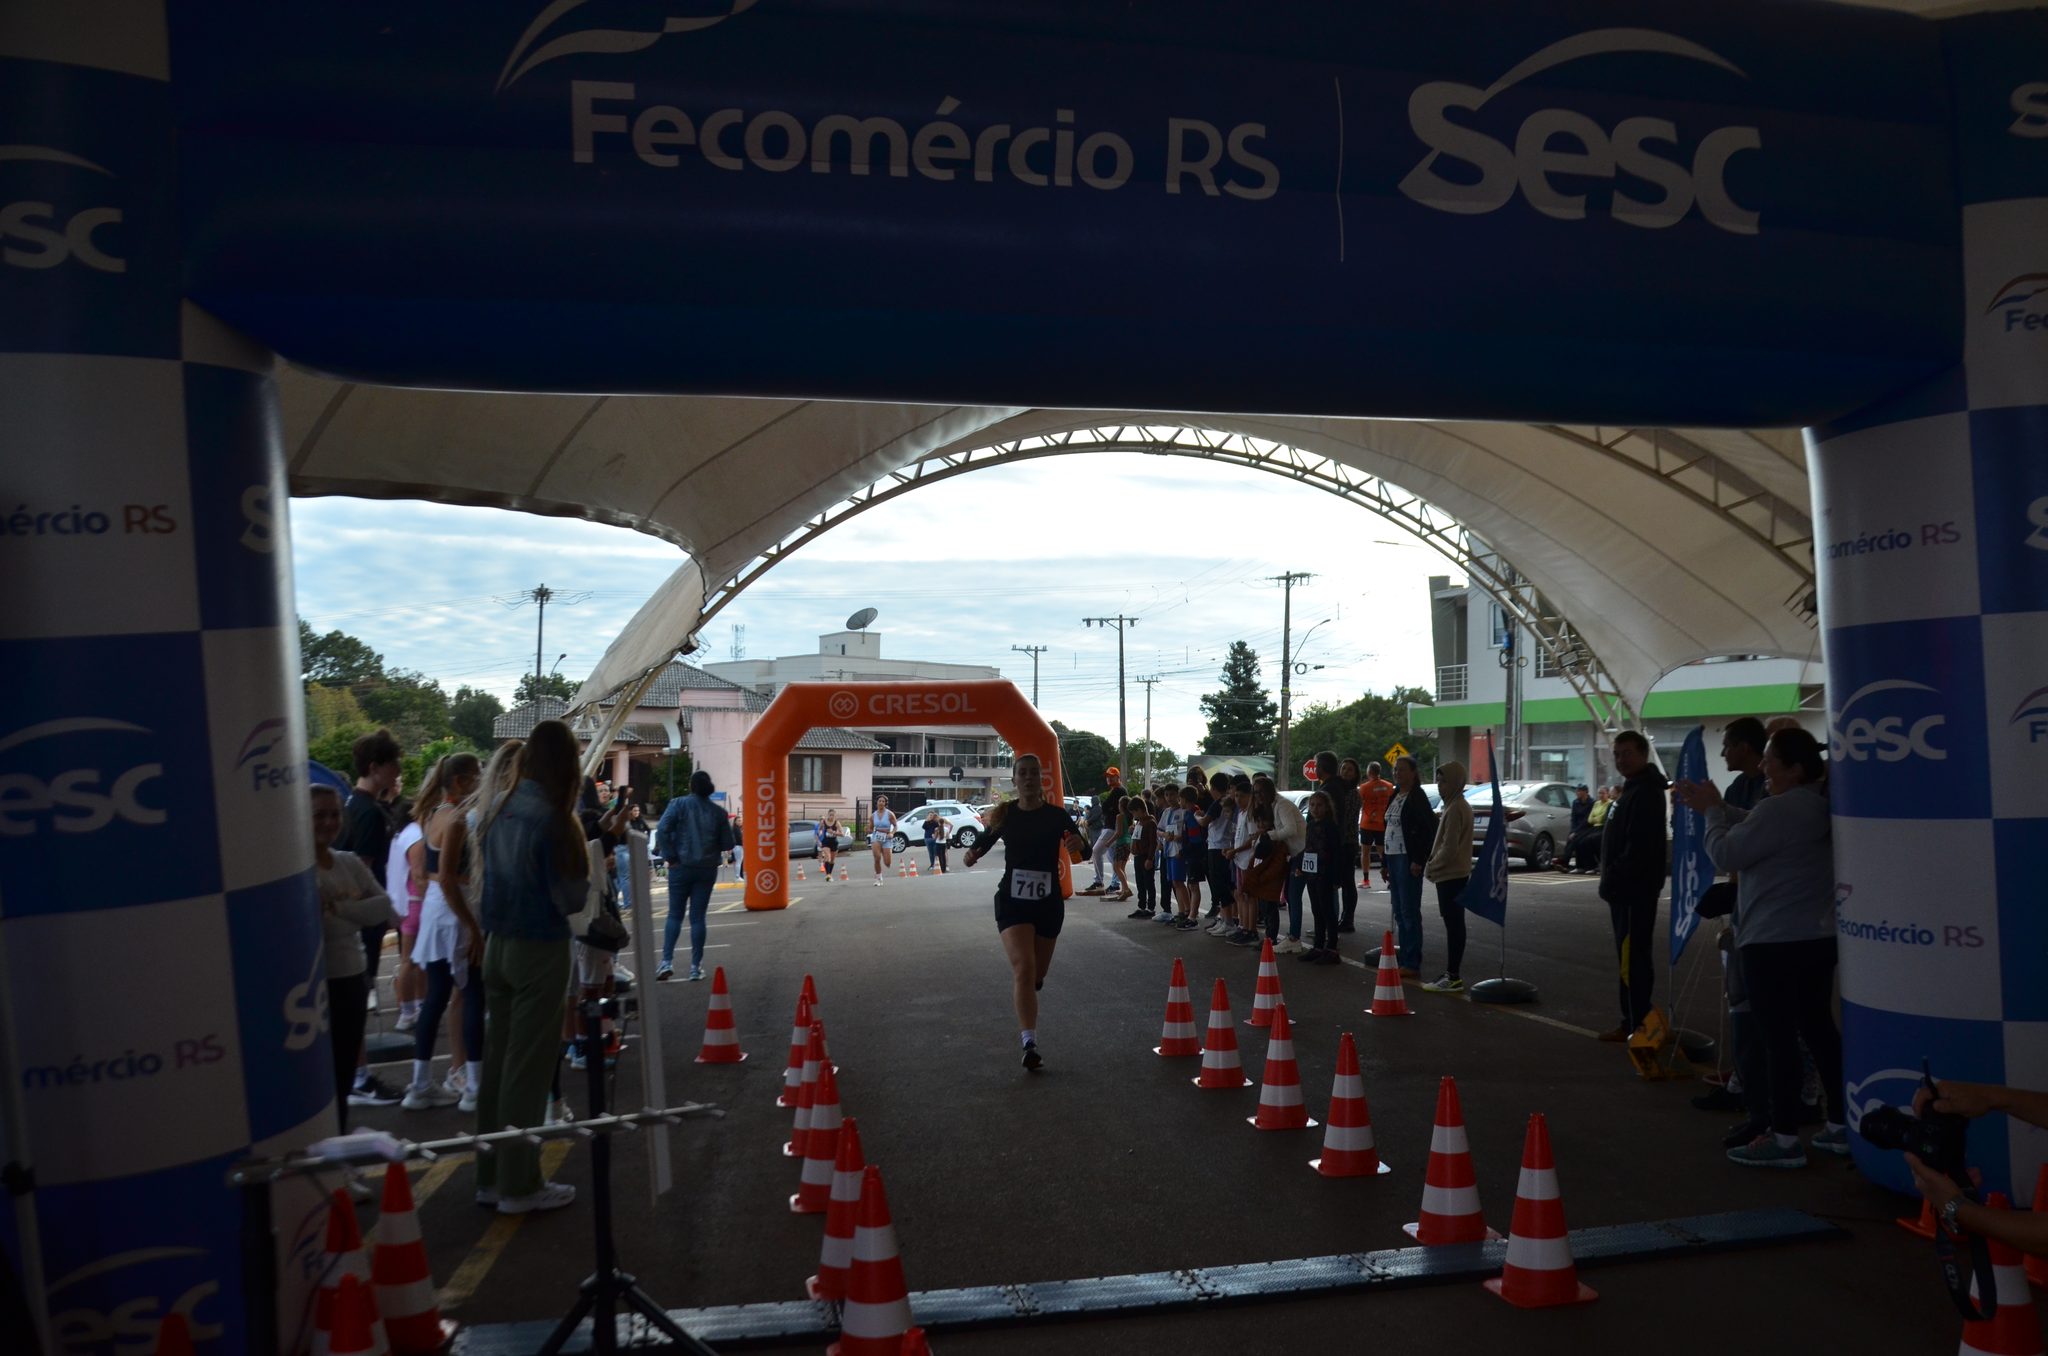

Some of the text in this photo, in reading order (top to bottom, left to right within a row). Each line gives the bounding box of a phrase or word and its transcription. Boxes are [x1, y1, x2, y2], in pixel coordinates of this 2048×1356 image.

[570, 79, 1281, 201] Fecomércio RS
[1397, 79, 1762, 235] Sesc
[124, 504, 177, 534] RS
[1921, 522, 1961, 546] RS
[868, 692, 977, 715] CRESOL
[757, 769, 776, 861] CRESOL
[1016, 879, 1046, 898] 716
[1675, 851, 1699, 940] Sesc
[1943, 925, 1985, 948] RS
[174, 1034, 226, 1070] RS
